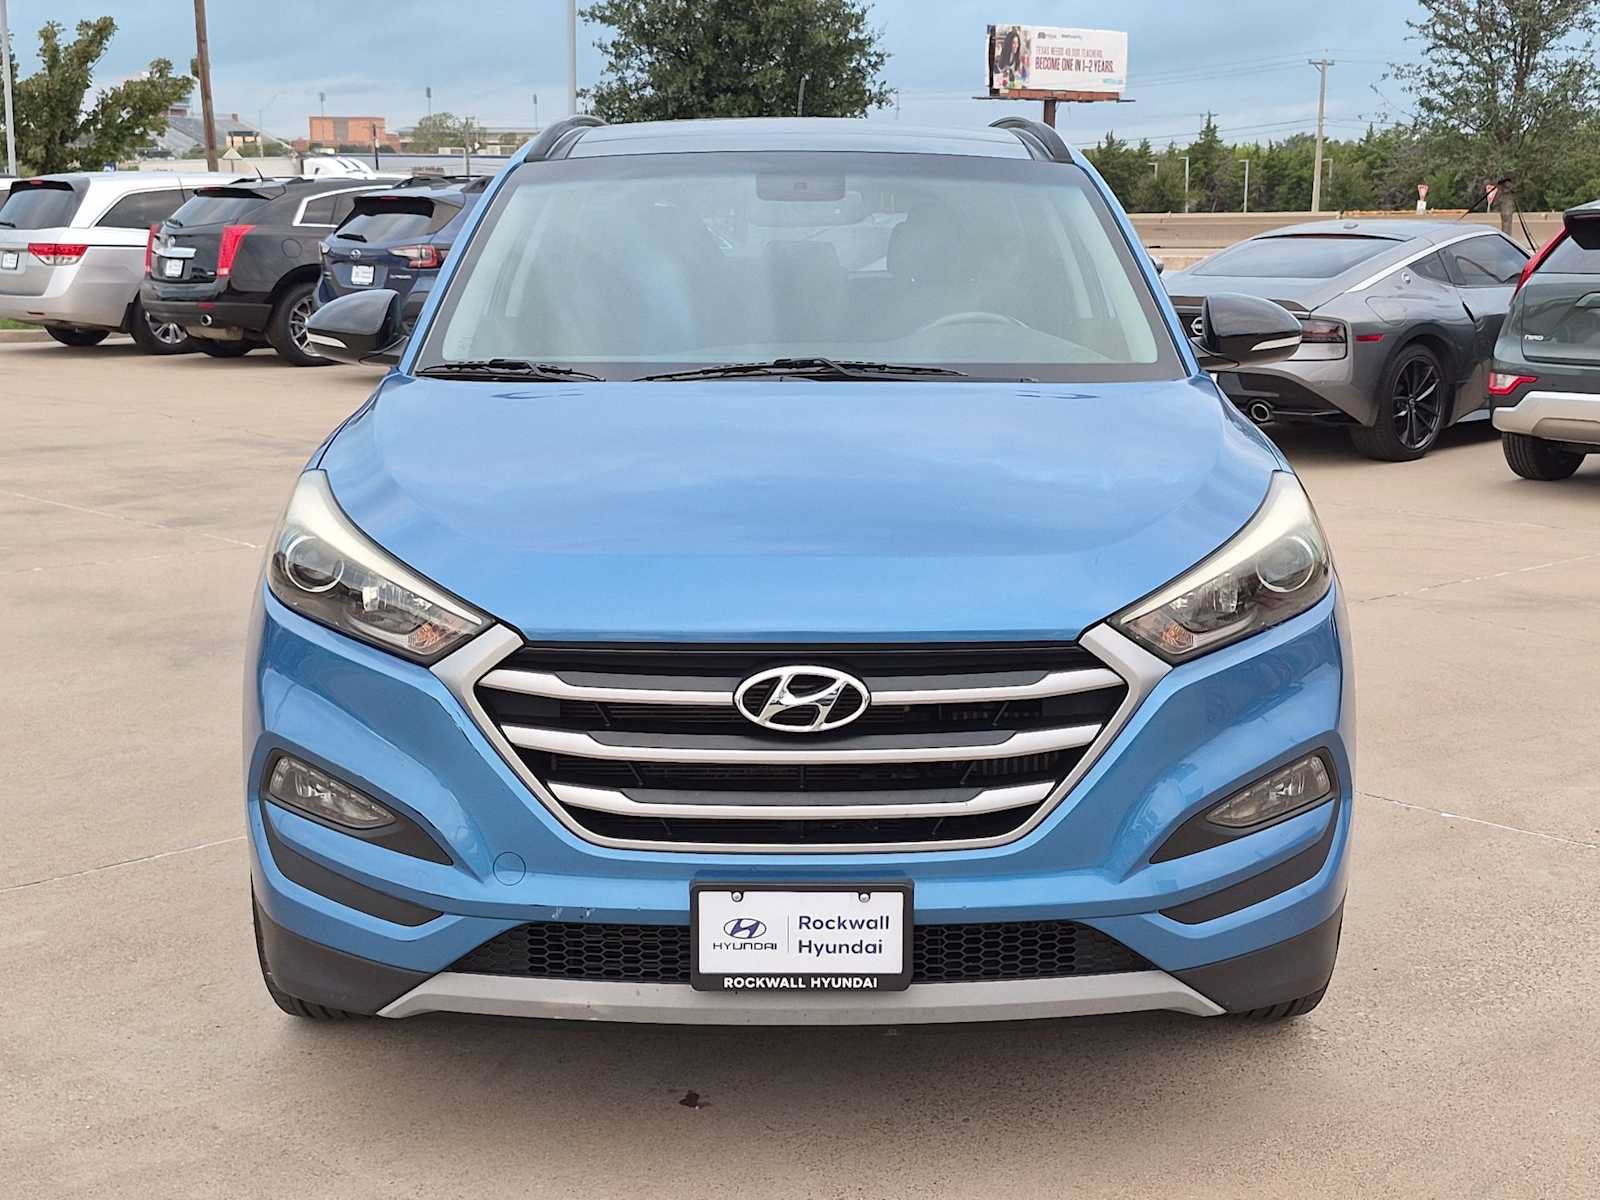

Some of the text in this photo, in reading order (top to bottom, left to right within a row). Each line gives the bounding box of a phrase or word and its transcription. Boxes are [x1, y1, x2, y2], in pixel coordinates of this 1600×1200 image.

[1035, 56, 1060, 71] BECOME
[1061, 57, 1074, 71] ONE
[1075, 58, 1081, 72] IN
[1082, 59, 1093, 72] 1-2
[798, 915, 890, 930] Rockwall
[712, 942, 778, 951] HYUNDAI
[798, 939, 883, 957] Hyundai
[723, 977, 877, 989] ROCKWALL HYUNDAI
